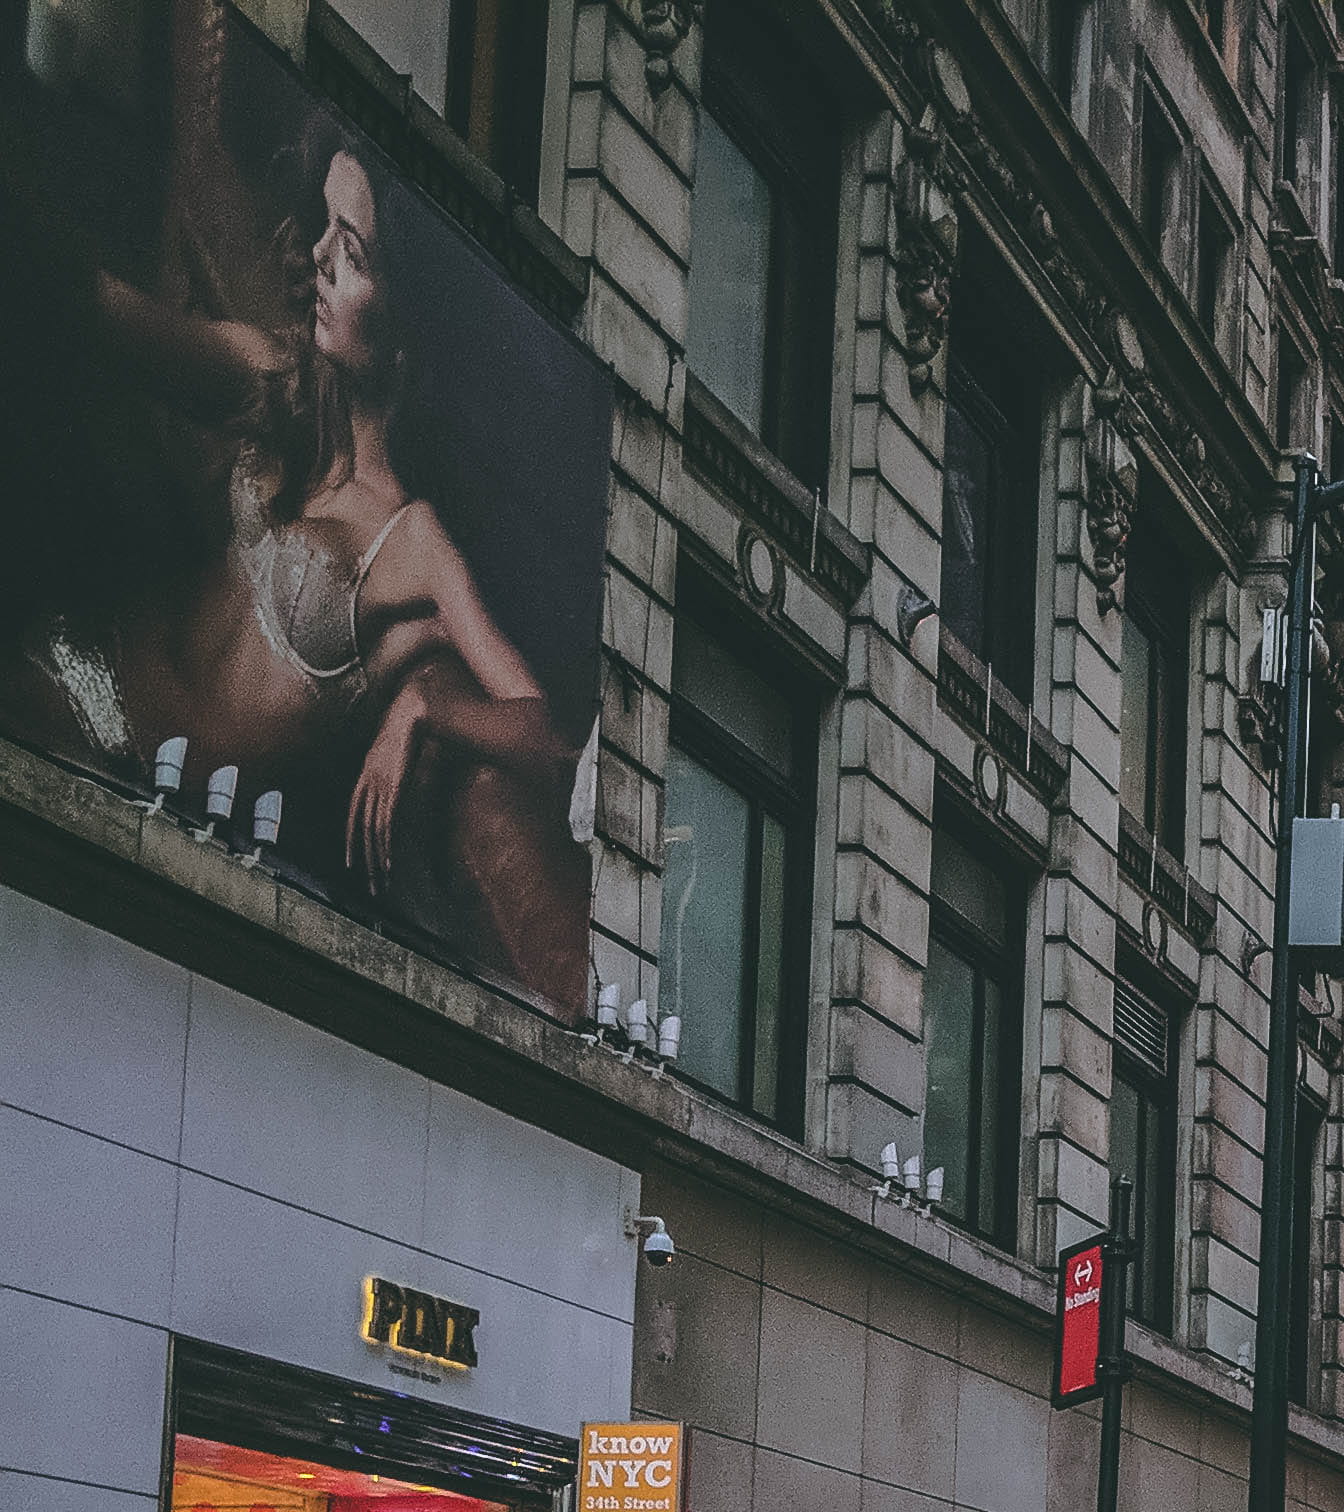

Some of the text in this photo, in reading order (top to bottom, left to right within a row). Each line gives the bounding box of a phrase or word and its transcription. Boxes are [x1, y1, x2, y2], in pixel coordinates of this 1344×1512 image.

[364, 1276, 481, 1368] PINK
[588, 1430, 673, 1455] know
[586, 1459, 672, 1488] NYC
[585, 1496, 670, 1510] 34th Street
